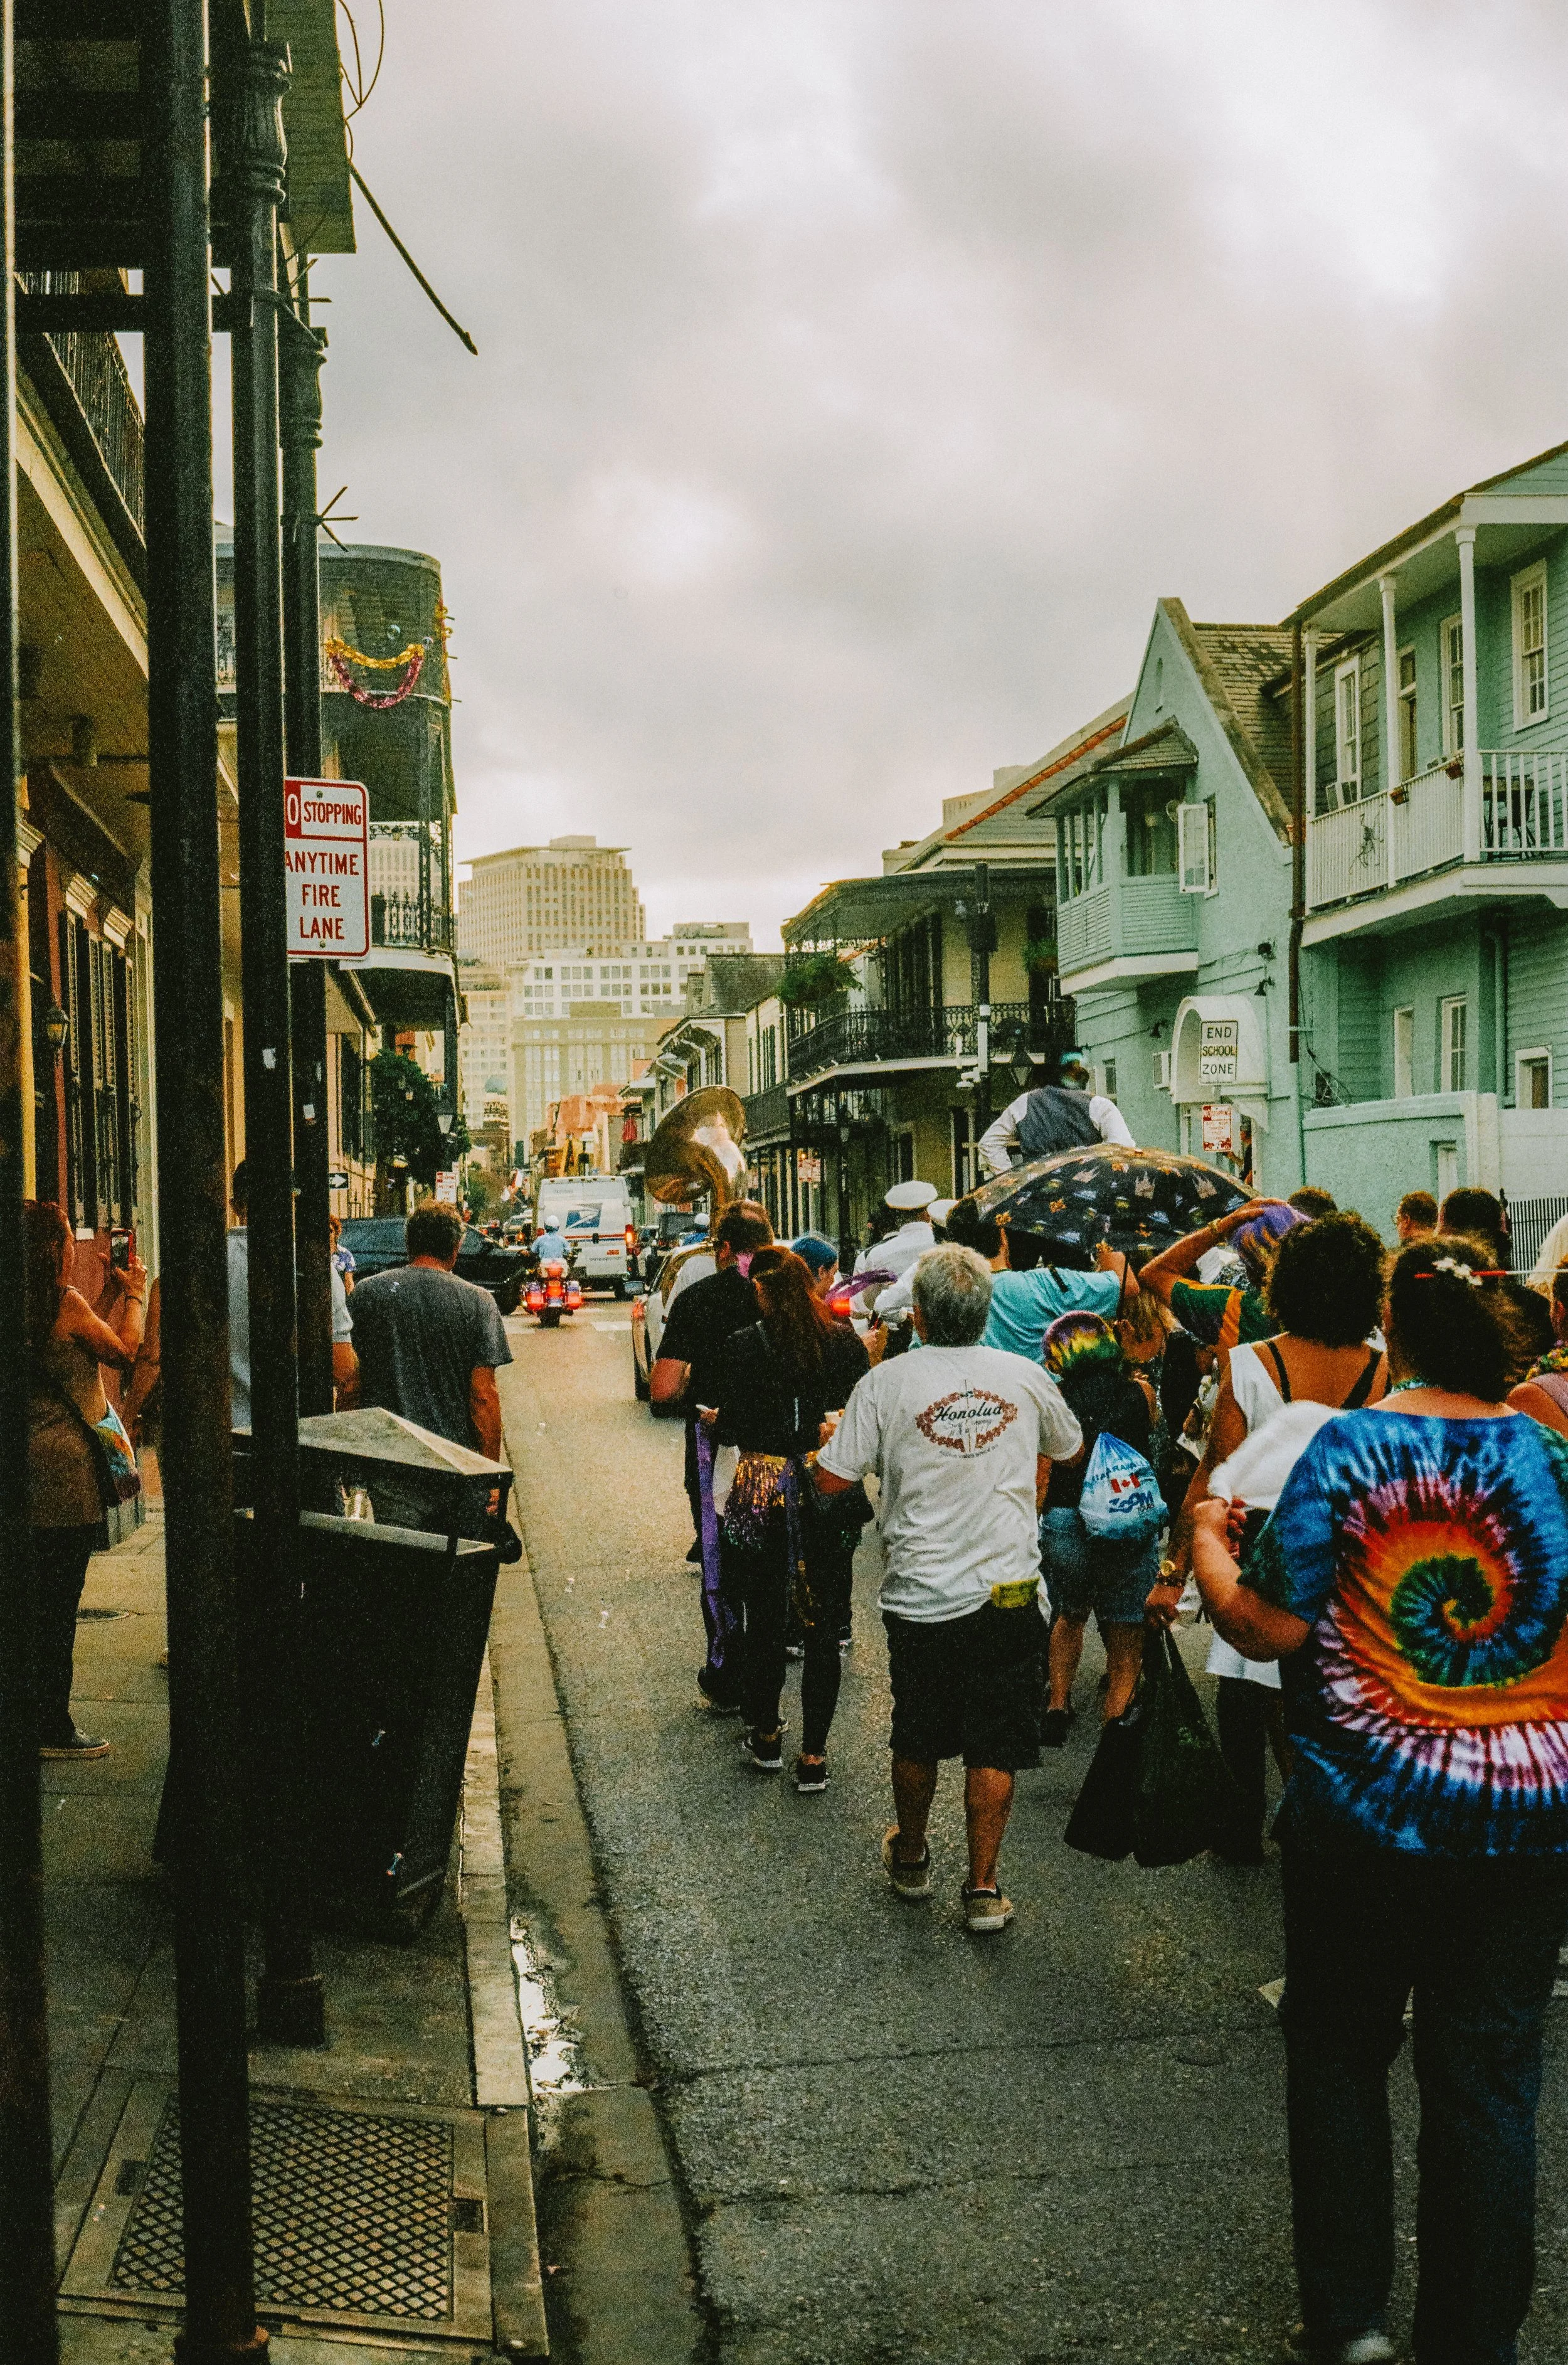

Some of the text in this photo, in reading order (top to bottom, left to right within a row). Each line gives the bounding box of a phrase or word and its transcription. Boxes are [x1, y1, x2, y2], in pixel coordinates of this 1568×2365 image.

[304, 800, 362, 826] STOPPING
[285, 850, 359, 876] ANYTIME
[302, 883, 341, 908] FIRE
[299, 917, 345, 940] LANE
[1206, 1026, 1232, 1039] END
[1202, 1045, 1236, 1056] SCHOOL
[1202, 1063, 1234, 1075] ZONE
[933, 1401, 1002, 1422] Honolua
[1108, 1491, 1154, 1514] ZOOM
